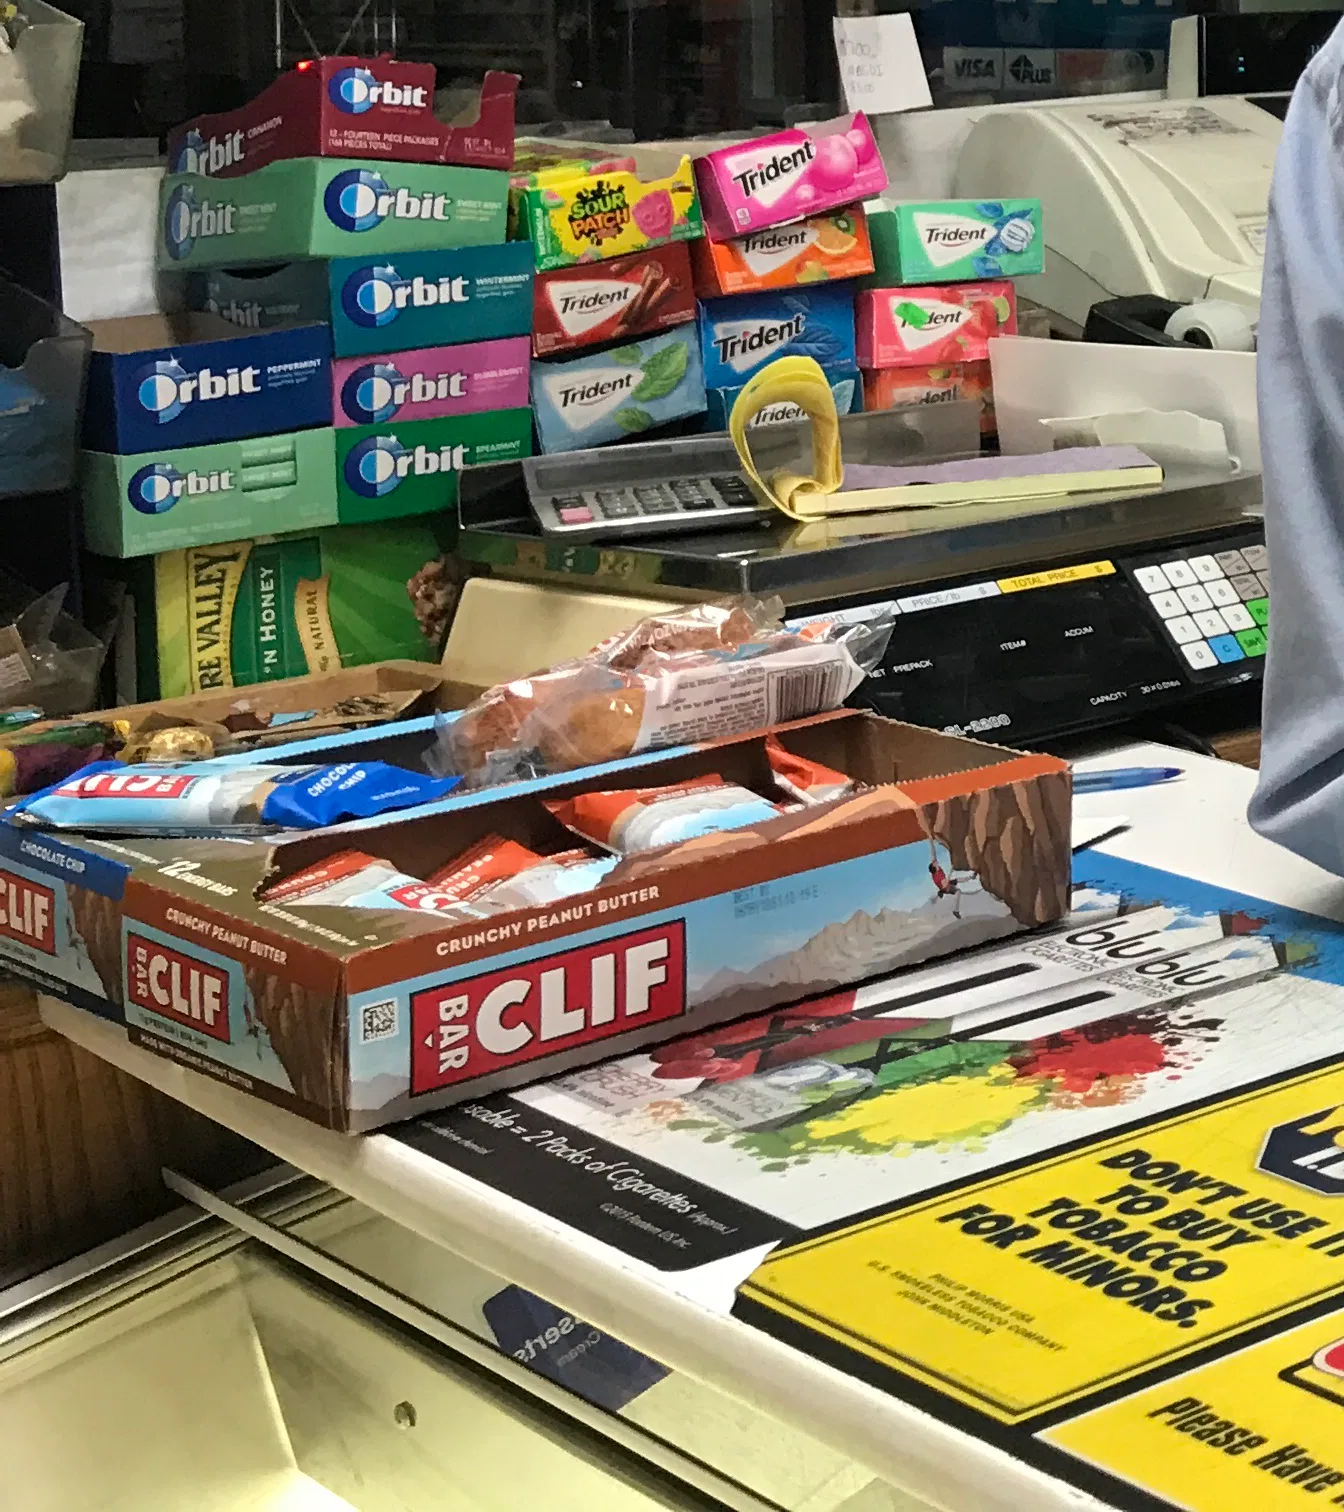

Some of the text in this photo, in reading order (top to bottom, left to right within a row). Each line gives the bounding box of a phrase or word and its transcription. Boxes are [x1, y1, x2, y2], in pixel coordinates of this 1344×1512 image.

[333, 72, 428, 111] Orbit
[953, 58, 996, 79] VISA
[733, 140, 815, 196] Trident
[571, 192, 628, 220] SOUR
[571, 207, 630, 240] PATCH
[925, 226, 993, 244] Trident
[194, 549, 241, 655] VALLEY
[259, 566, 275, 641] HONEY
[1010, 568, 1077, 589] TOTAL PRICE
[309, 589, 325, 650] NATURAL
[1064, 625, 1094, 637] ACCUM
[894, 659, 933, 674] PREPACK
[1089, 690, 1128, 706] CAPACITY
[20, 840, 86, 874] CHOCOLATE CHIP
[166, 907, 287, 965] CRUNCHY PEANUT BUTTER
[436, 886, 660, 957] CRUNCHY PEANUT BUTTER
[135, 945, 222, 1027] BAR CLIF
[438, 938, 669, 1074] BAR CLIF
[1095, 1184, 1267, 1252] TO BUY
[1099, 1148, 1249, 1206] DON'T
[1229, 1192, 1330, 1240] USE
[934, 1203, 1042, 1249] FOR
[1017, 1240, 1215, 1329] MINORS.
[1026, 1197, 1229, 1283] TOBACCO
[1147, 1396, 1269, 1456] Please
